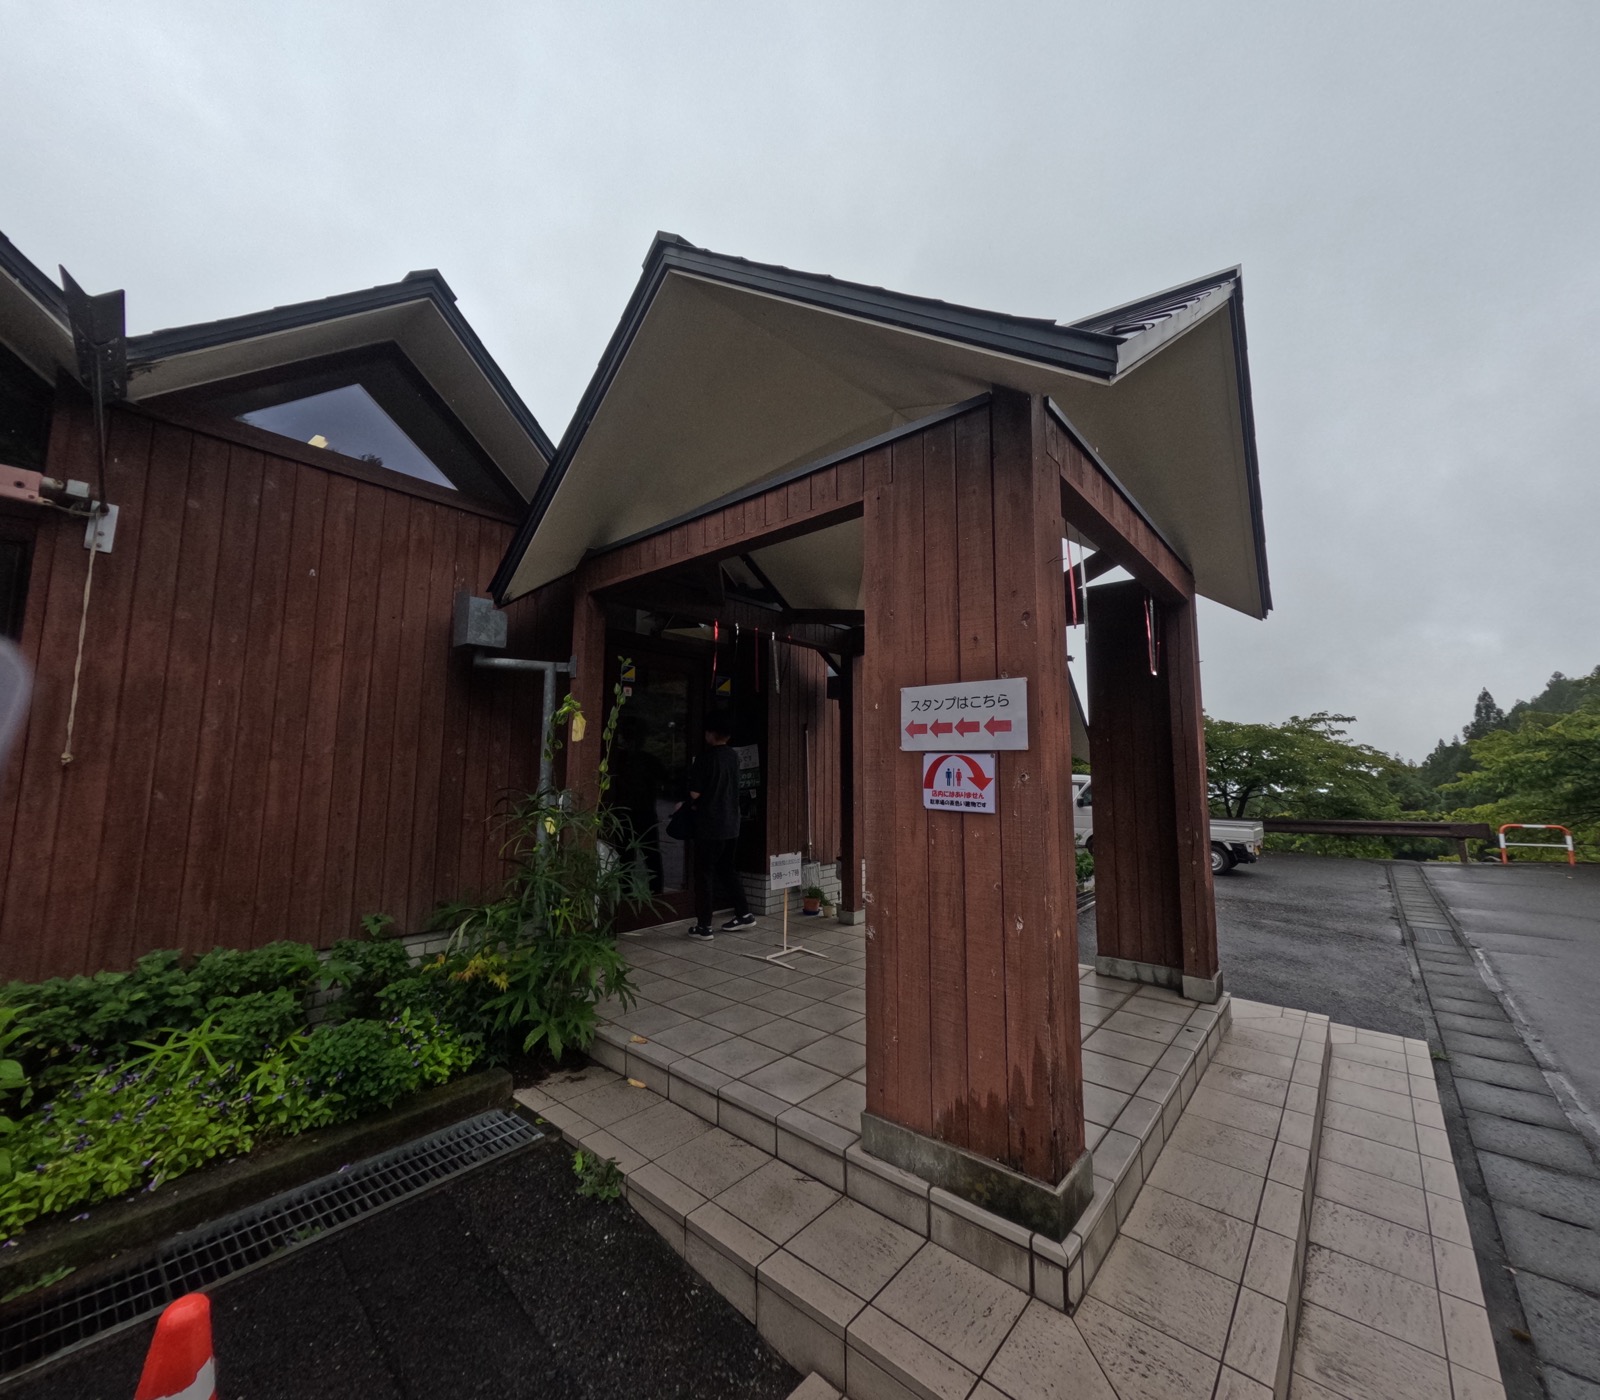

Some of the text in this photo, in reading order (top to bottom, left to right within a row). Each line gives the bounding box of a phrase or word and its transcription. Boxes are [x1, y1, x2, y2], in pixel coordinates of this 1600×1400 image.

[911, 694, 1010, 712] スタンプはこちら
[931, 790, 985, 799] 店内にはありません
